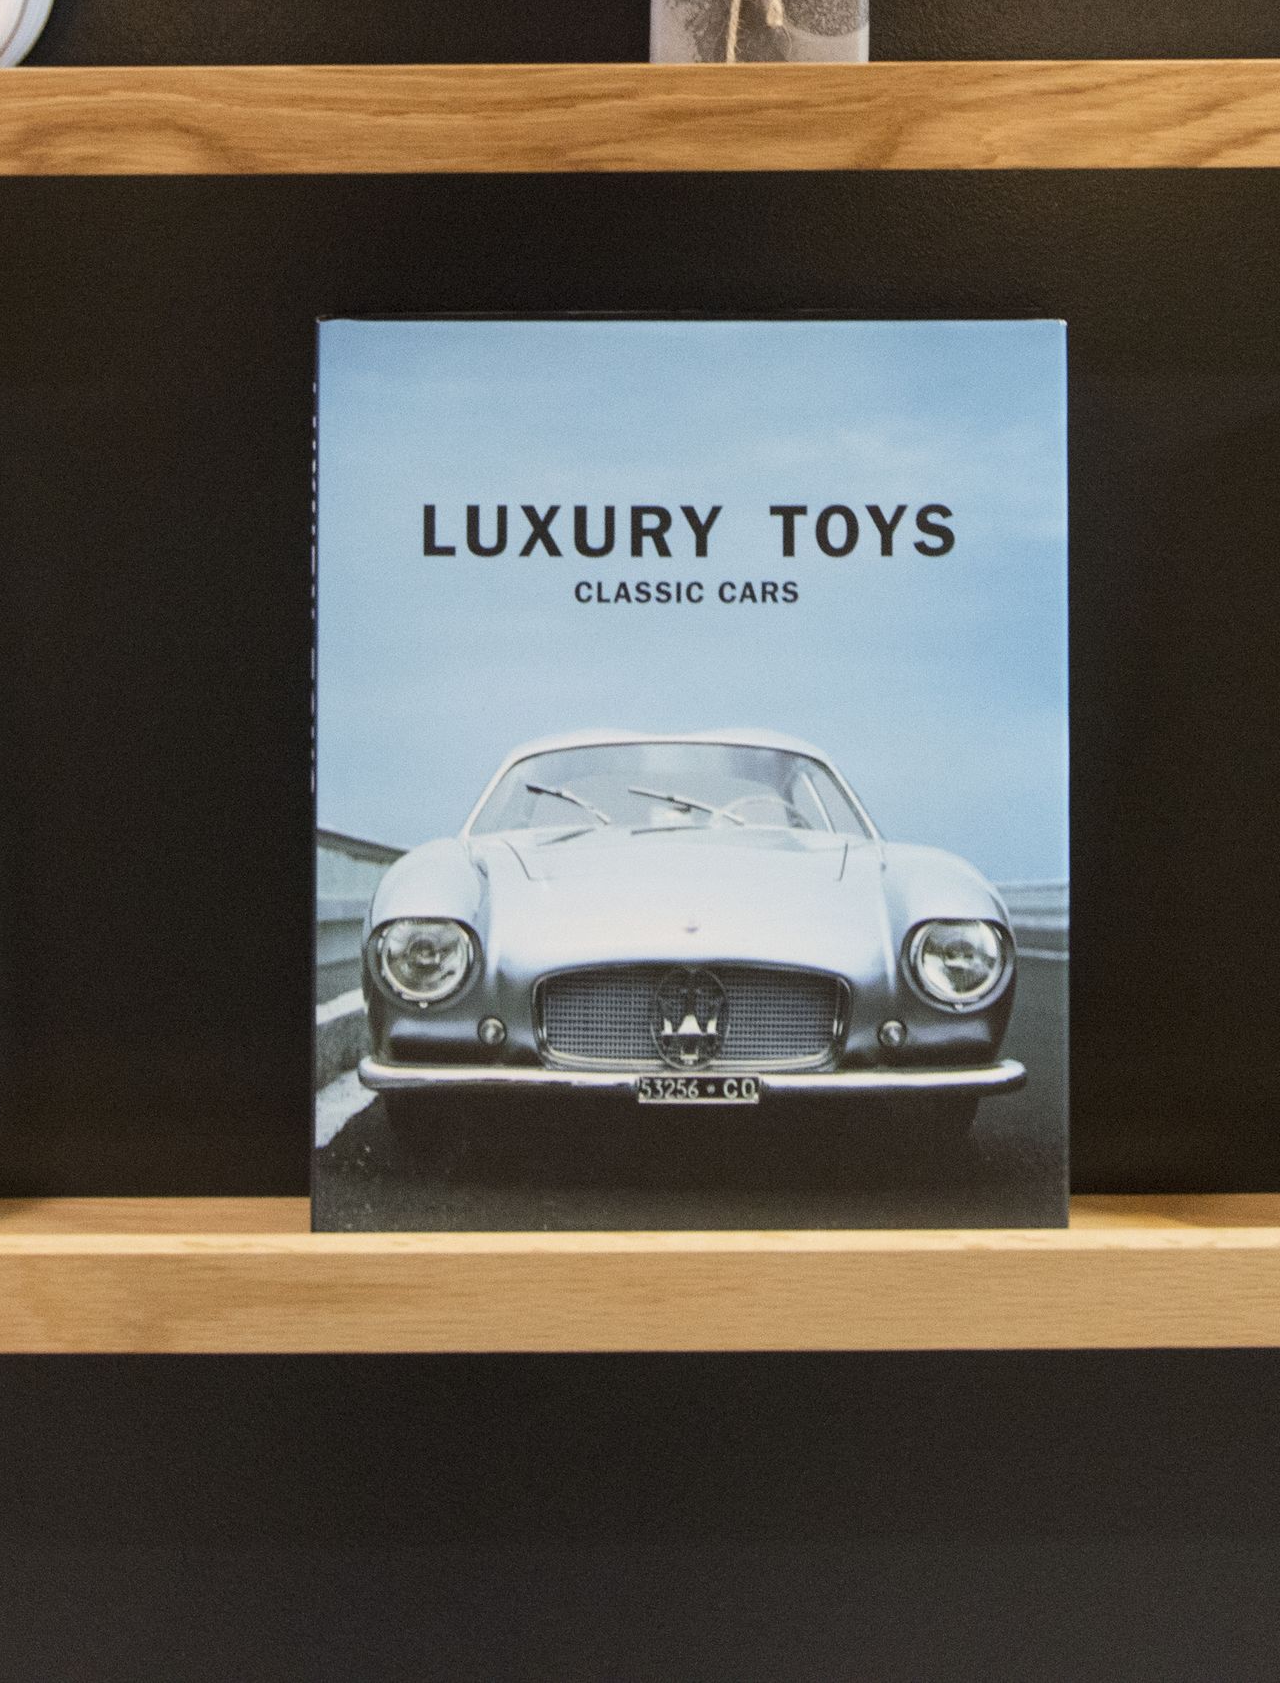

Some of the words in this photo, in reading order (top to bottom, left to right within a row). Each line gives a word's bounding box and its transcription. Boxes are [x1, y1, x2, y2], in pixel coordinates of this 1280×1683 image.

[423, 504, 722, 557] LUXURY
[769, 503, 956, 558] TOYS
[574, 581, 704, 604] CLASSIC
[718, 581, 800, 604] CARS
[640, 1078, 699, 1099] 53256
